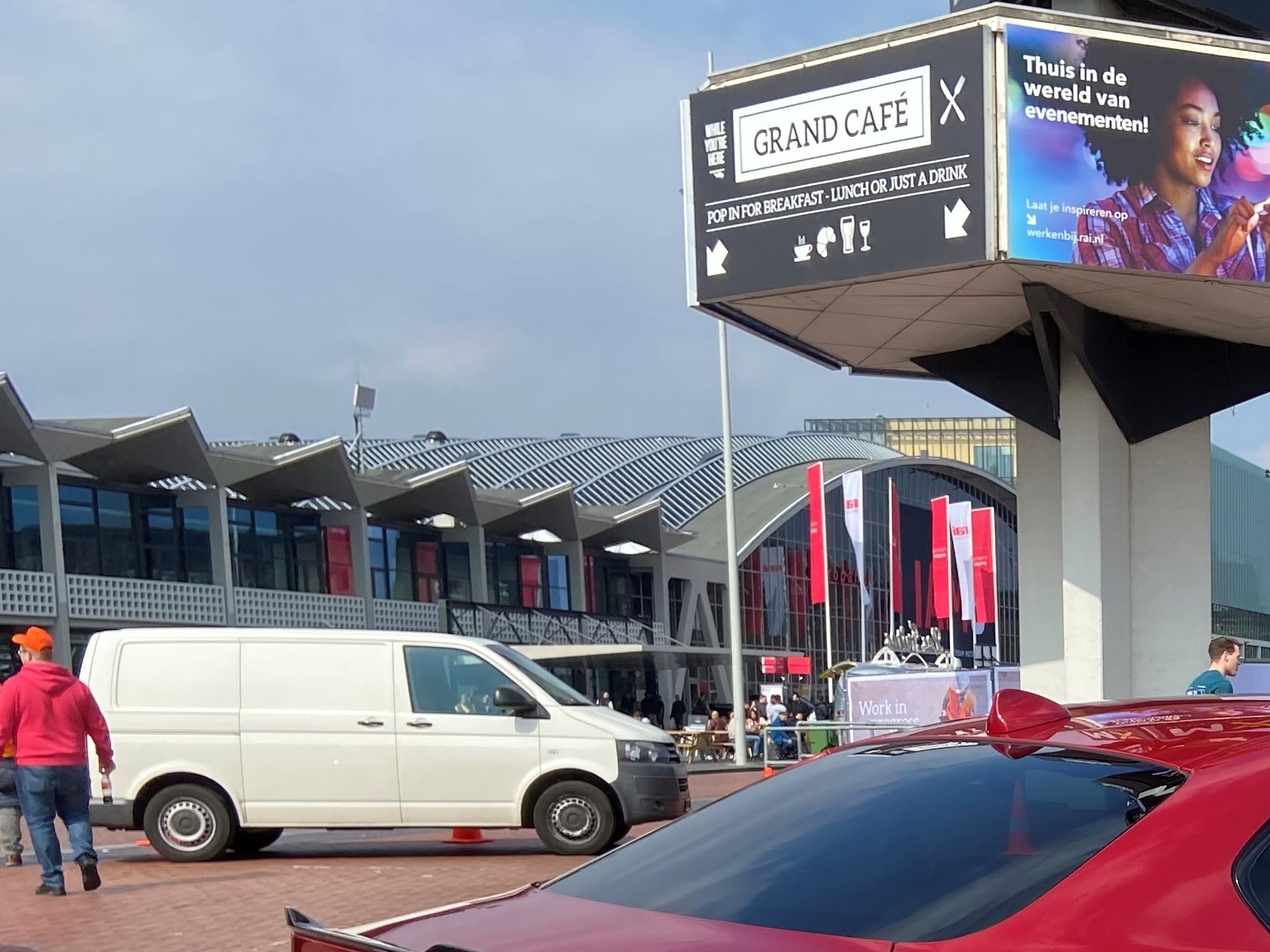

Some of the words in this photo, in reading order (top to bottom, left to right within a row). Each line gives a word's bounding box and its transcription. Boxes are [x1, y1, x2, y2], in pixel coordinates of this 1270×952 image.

[1023, 55, 1075, 79] Thuis
[1080, 62, 1098, 82] in
[1102, 66, 1127, 86] de
[1024, 81, 1091, 104] wereld
[1096, 92, 1130, 109] van
[753, 114, 838, 156] GRAND
[844, 91, 908, 137] CAFÉ
[1025, 105, 1148, 134] evenementen!
[707, 151, 725, 167] HERE
[707, 208, 728, 225] POP
[729, 205, 740, 221] IN
[741, 202, 762, 219] FOR
[763, 190, 824, 215] BREAKFAST
[831, 181, 869, 202] LUNCH
[871, 178, 888, 195] OR
[889, 173, 916, 191] JUST
[918, 171, 928, 186] A
[929, 163, 968, 182] DRINK
[1026, 199, 1047, 211] Laat
[1049, 201, 1060, 214] je
[1062, 203, 1112, 218] inspireren
[1114, 211, 1128, 222] op
[1027, 228, 1104, 244] werkenbij.rai.nl
[858, 700, 891, 716] Work
[895, 702, 908, 715] in
